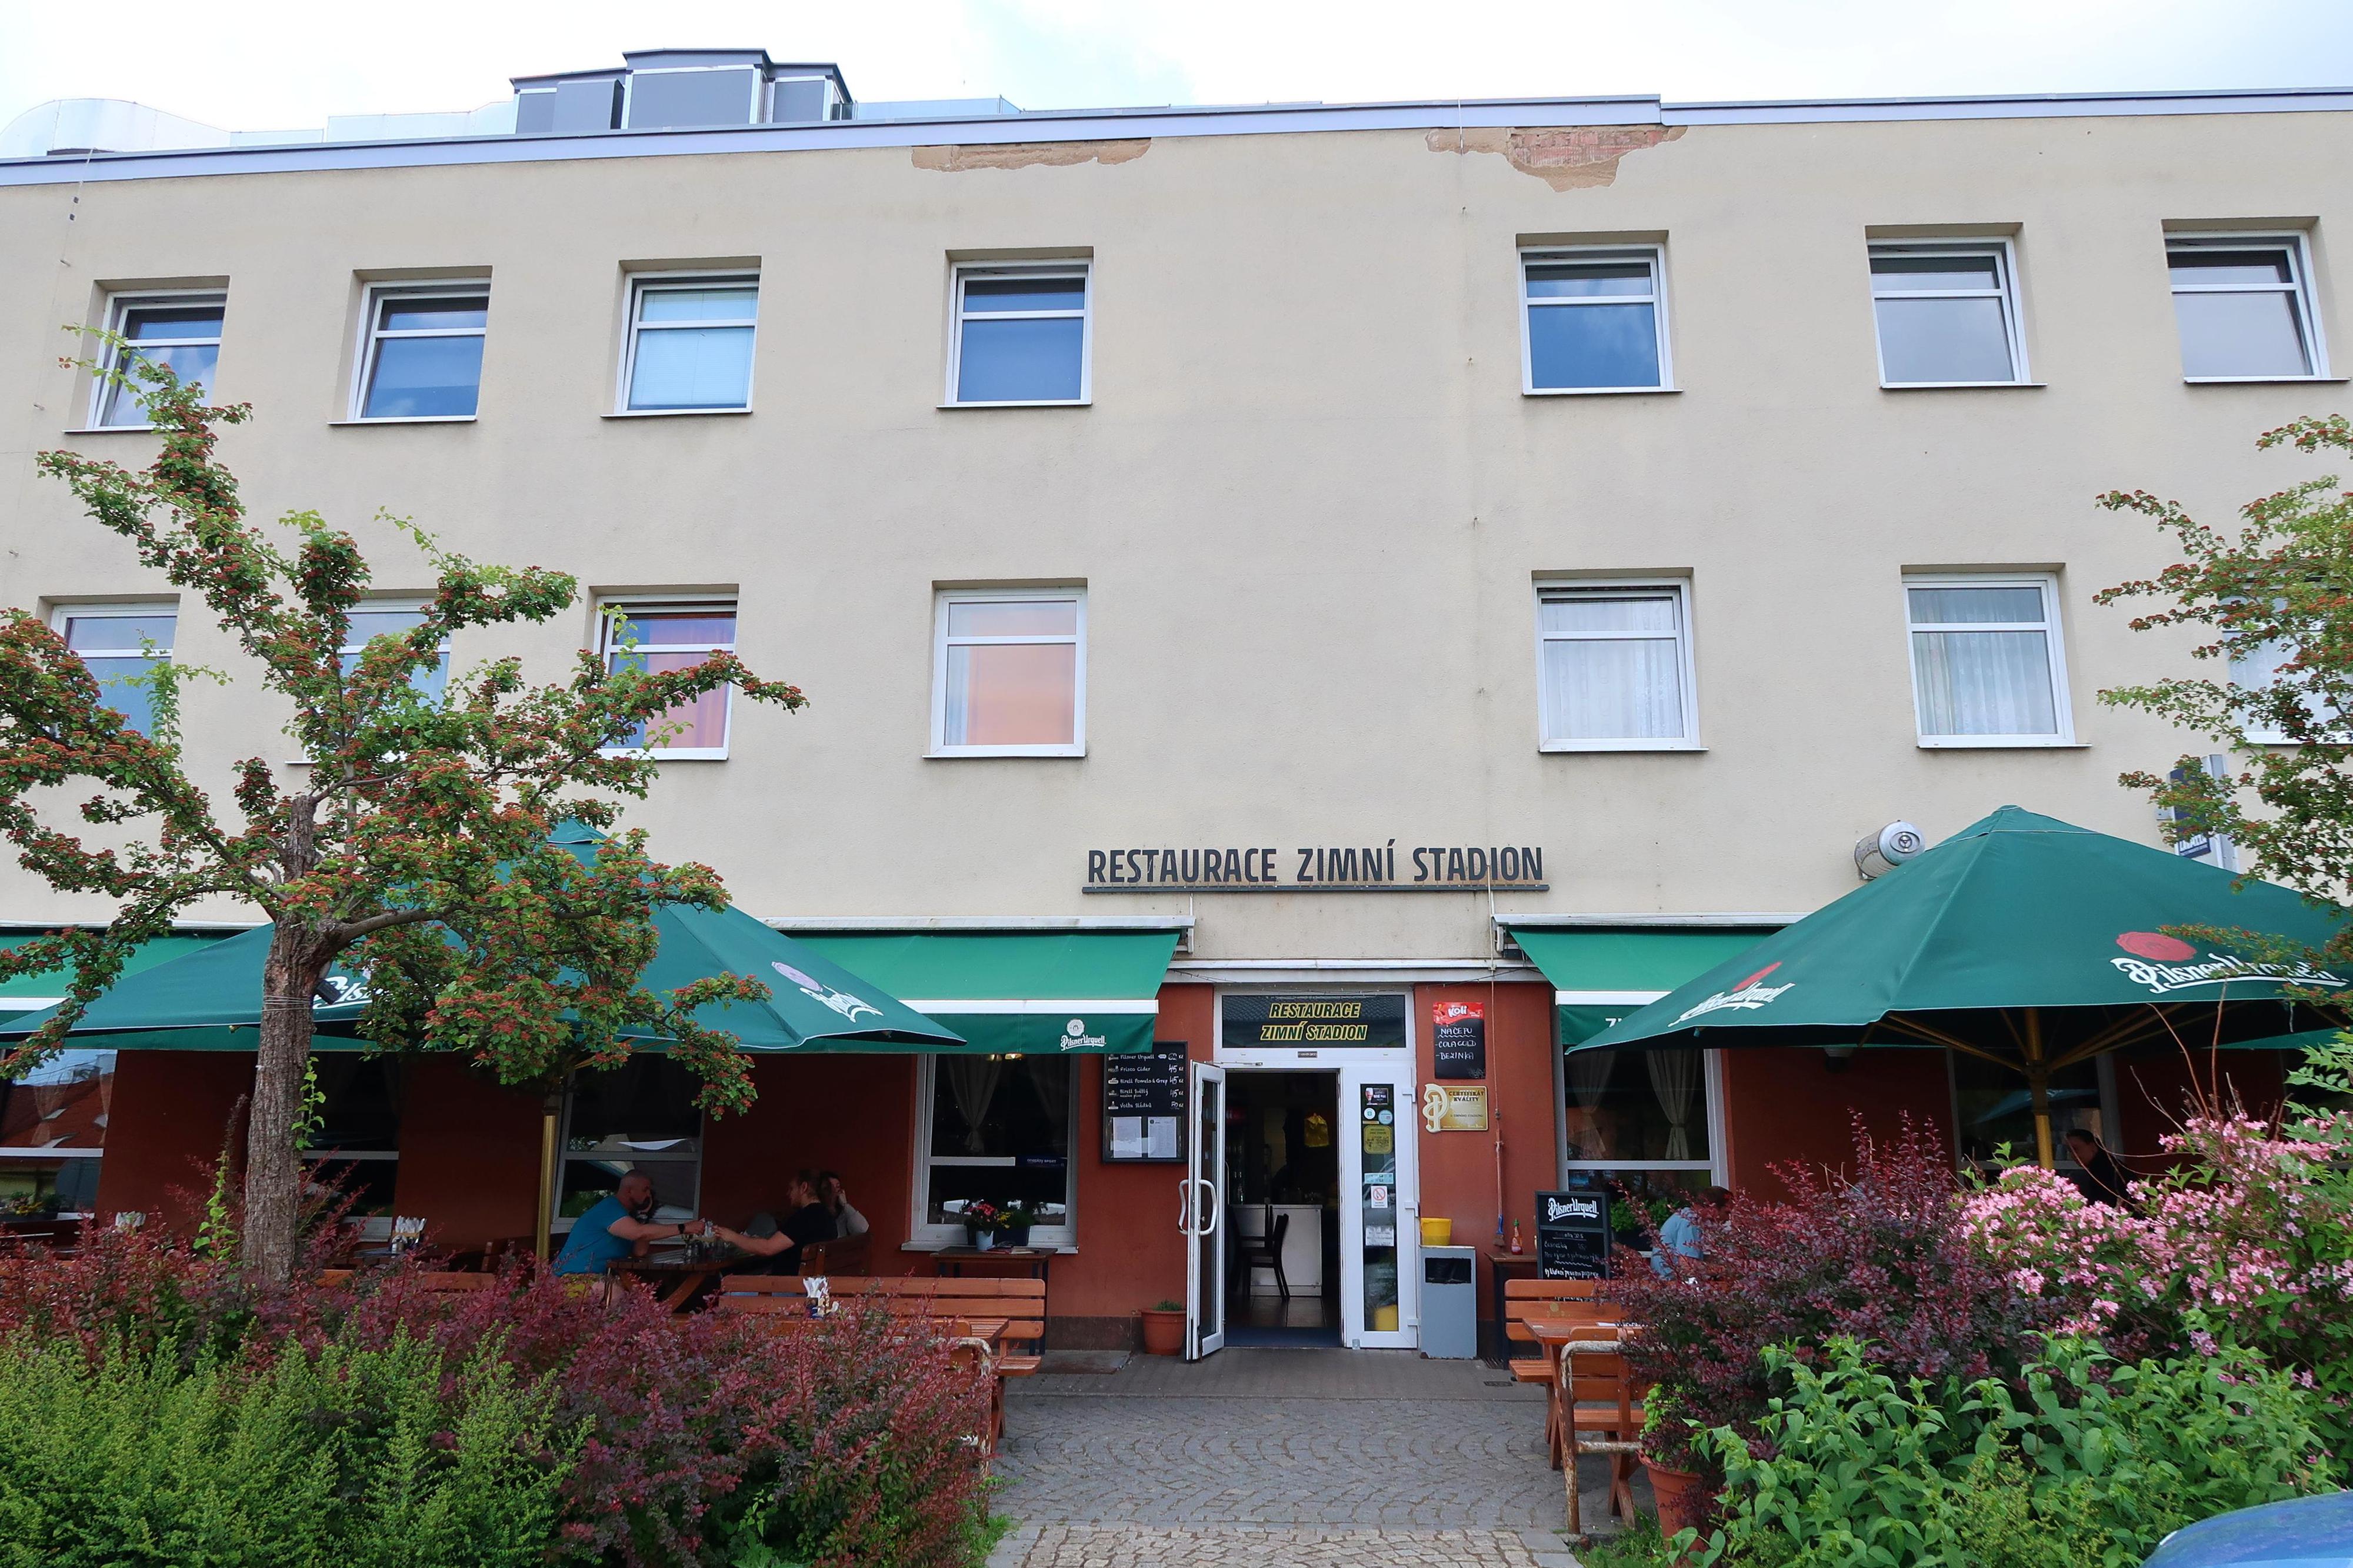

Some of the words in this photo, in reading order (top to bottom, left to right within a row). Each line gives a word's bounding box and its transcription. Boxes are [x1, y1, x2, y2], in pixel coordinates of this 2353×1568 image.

[1088, 849, 1277, 882] RESTAURACE
[1297, 839, 1395, 881] ZIMNÍ
[1413, 846, 1543, 881] STADION
[1269, 1003, 1361, 1018] RESTAURACE
[1260, 1021, 1308, 1040] ZIMNÍ
[1305, 1025, 1368, 1040] STADION
[1060, 1035, 1084, 1052] Pilsner
[1168, 1064, 1178, 1073] 45
[1169, 1076, 1179, 1085] 45
[1170, 1089, 1179, 1097] 45
[1548, 1197, 1572, 1222] Pilsner
